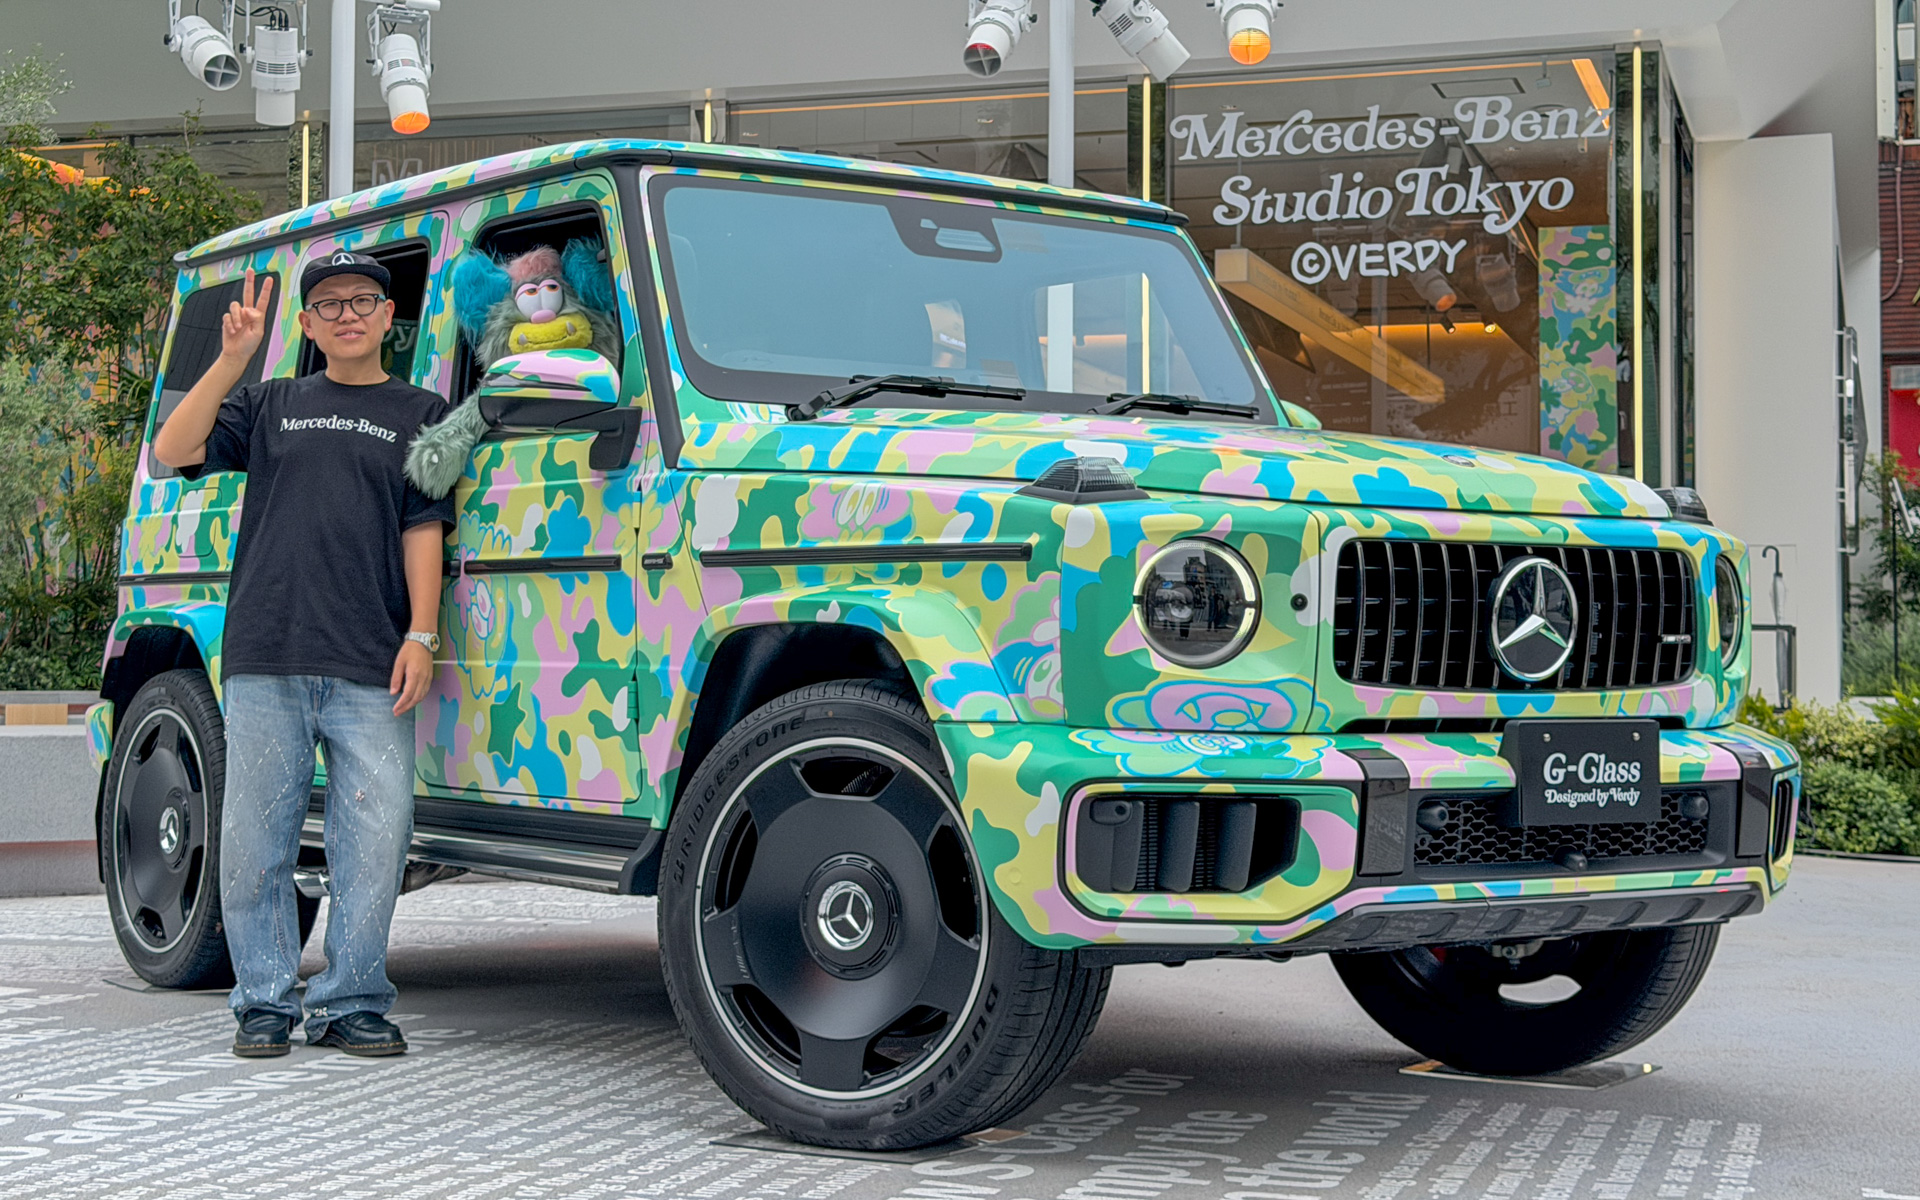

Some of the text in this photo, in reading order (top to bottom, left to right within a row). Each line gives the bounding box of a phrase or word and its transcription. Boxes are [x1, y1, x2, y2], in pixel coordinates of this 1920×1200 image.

[1169, 96, 1614, 161] Mercedes-Benz
[280, 415, 397, 442] Mercedes-Benz
[1543, 752, 1641, 785] G-Class
[673, 716, 804, 885] BRIDGESTONE
[1544, 787, 1640, 808] Designed by Verdy
[9, 1067, 211, 1102] that
[24, 1070, 328, 1143] achieve
[1134, 1110, 1269, 1145] the
[1223, 1090, 1431, 1190] the world
[307, 1148, 395, 1170] know
